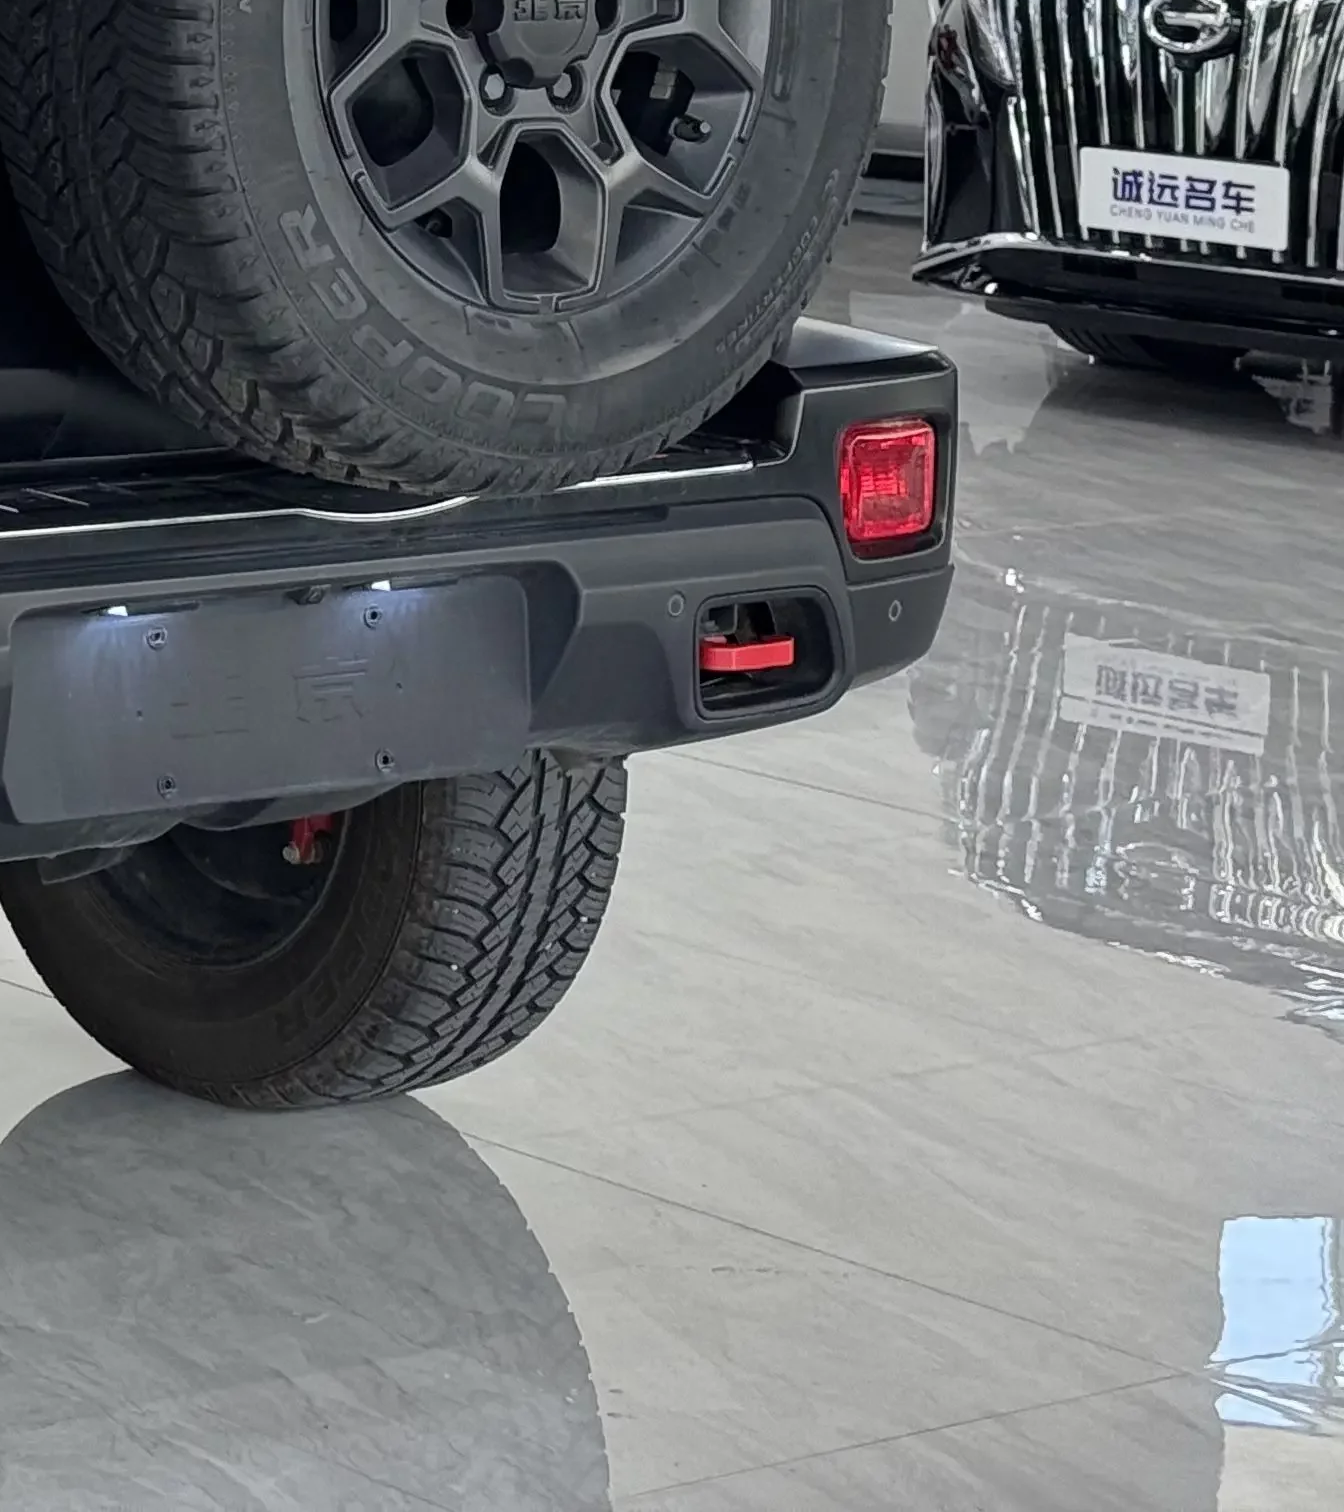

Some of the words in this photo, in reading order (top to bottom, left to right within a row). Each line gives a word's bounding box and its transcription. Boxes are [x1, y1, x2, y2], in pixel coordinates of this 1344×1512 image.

[1111, 167, 1256, 216] 诚远名车
[1109, 204, 1153, 221] CHENG
[1156, 209, 1190, 225] YUAN
[1192, 214, 1226, 230] MING
[1229, 218, 1256, 234] CHE
